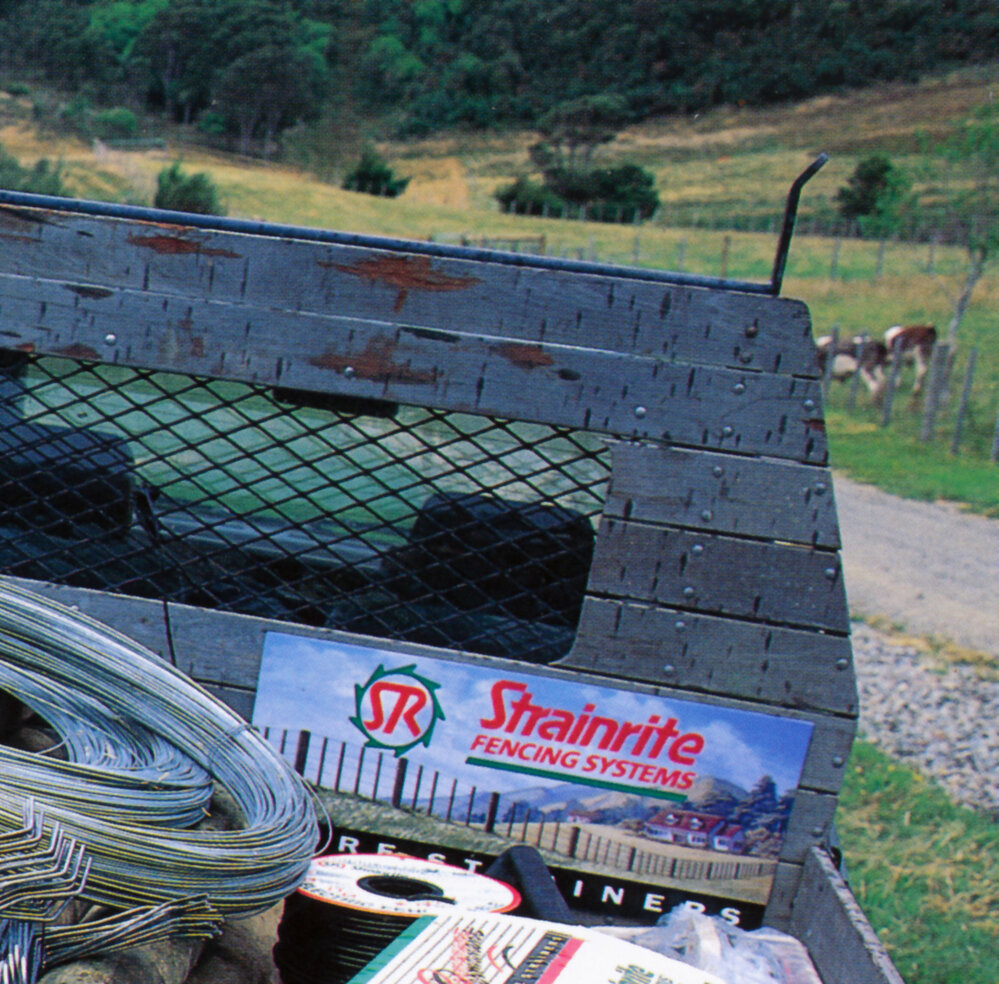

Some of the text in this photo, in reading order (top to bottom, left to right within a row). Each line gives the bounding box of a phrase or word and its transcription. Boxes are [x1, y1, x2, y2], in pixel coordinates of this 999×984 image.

[363, 681, 427, 738] SR
[478, 679, 705, 766] Strainrite
[469, 735, 697, 790] FENCING SYSTEMS
